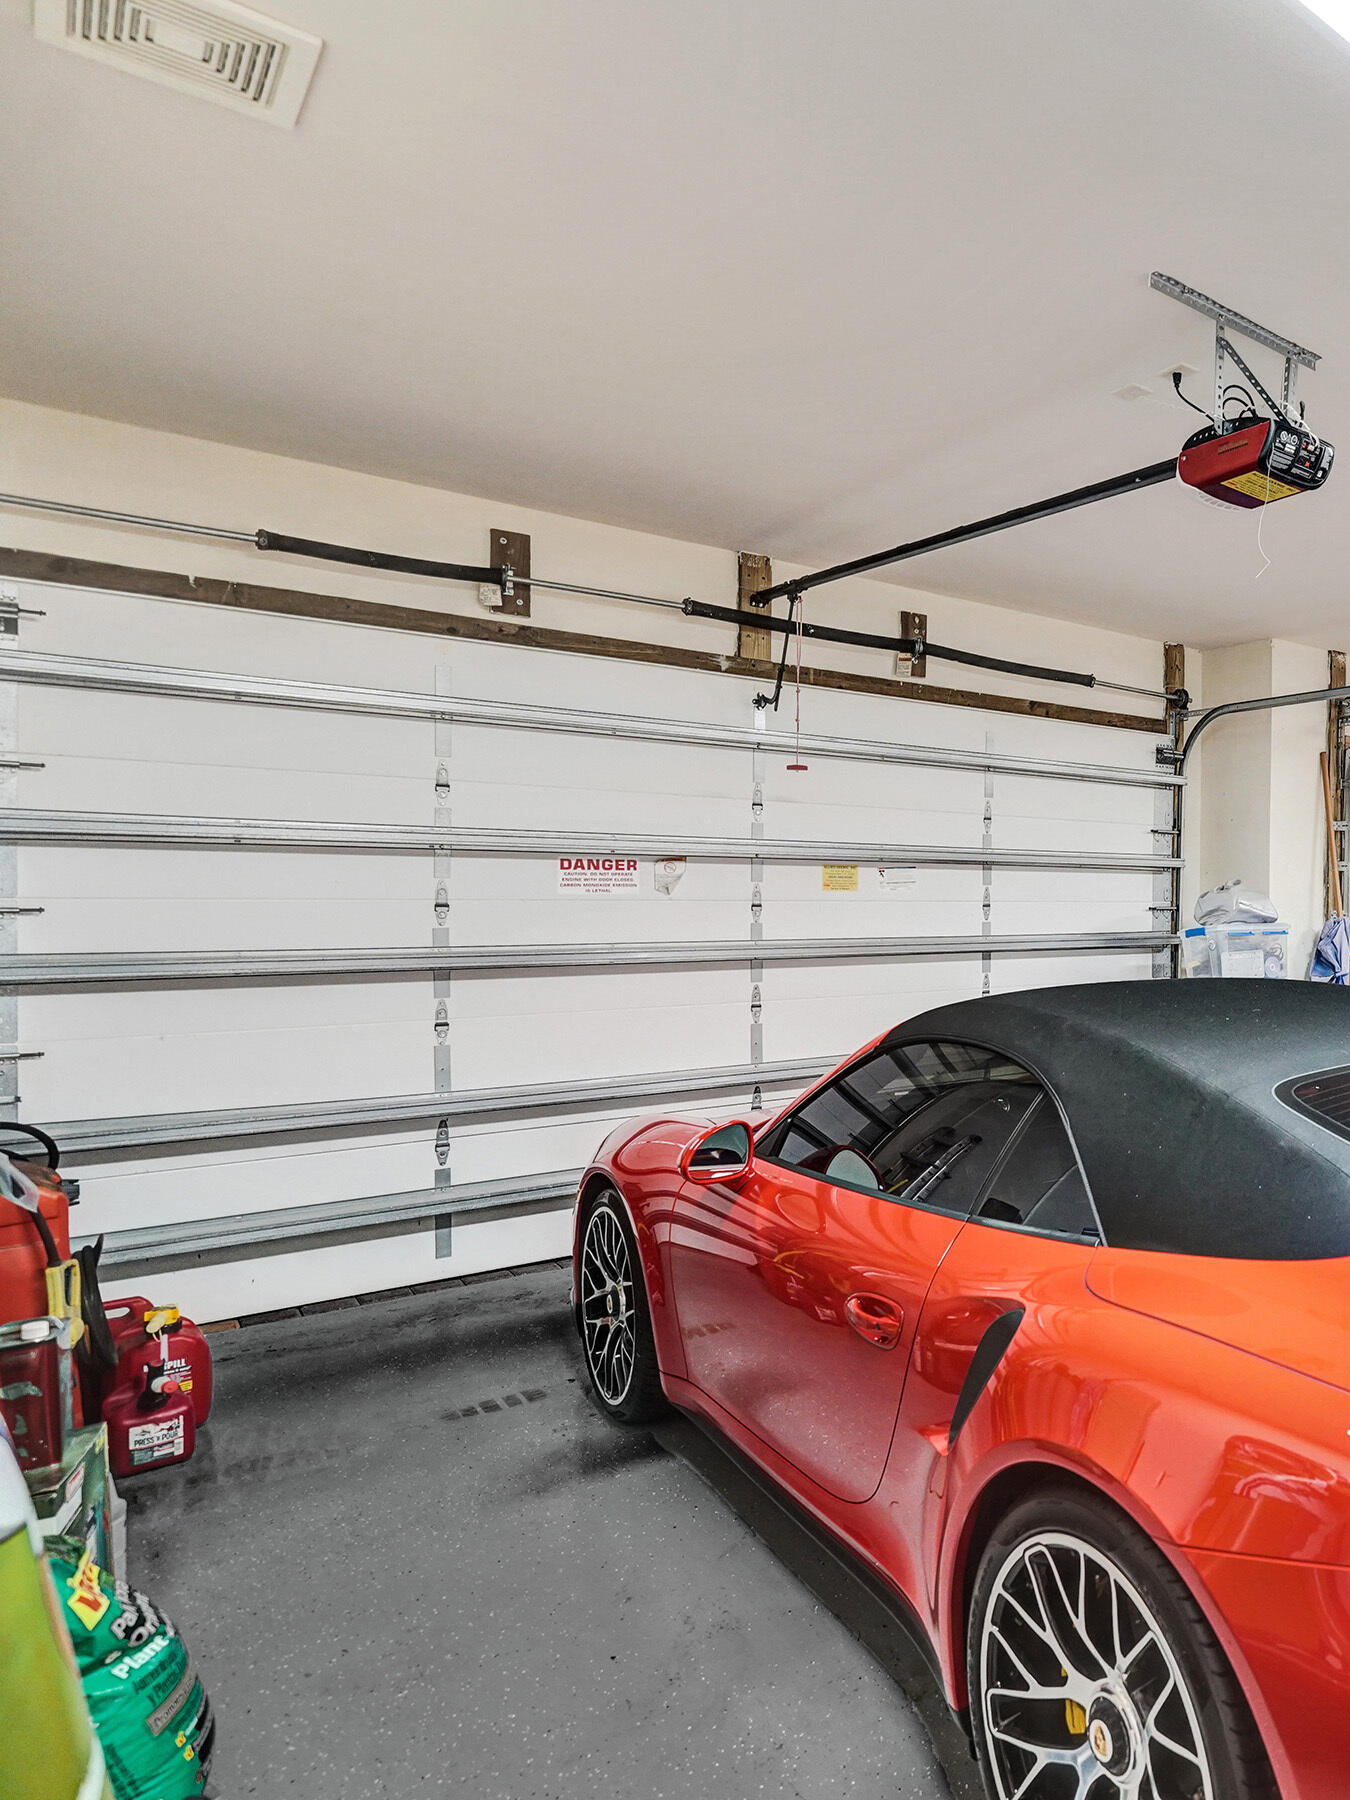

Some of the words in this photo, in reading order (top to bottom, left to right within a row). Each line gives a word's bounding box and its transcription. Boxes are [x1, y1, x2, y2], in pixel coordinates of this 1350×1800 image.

[559, 858, 638, 871] DANGER
[133, 1435, 155, 1448] PRESS
[161, 1429, 179, 1441] POUR
[110, 1634, 170, 1680] Plant
